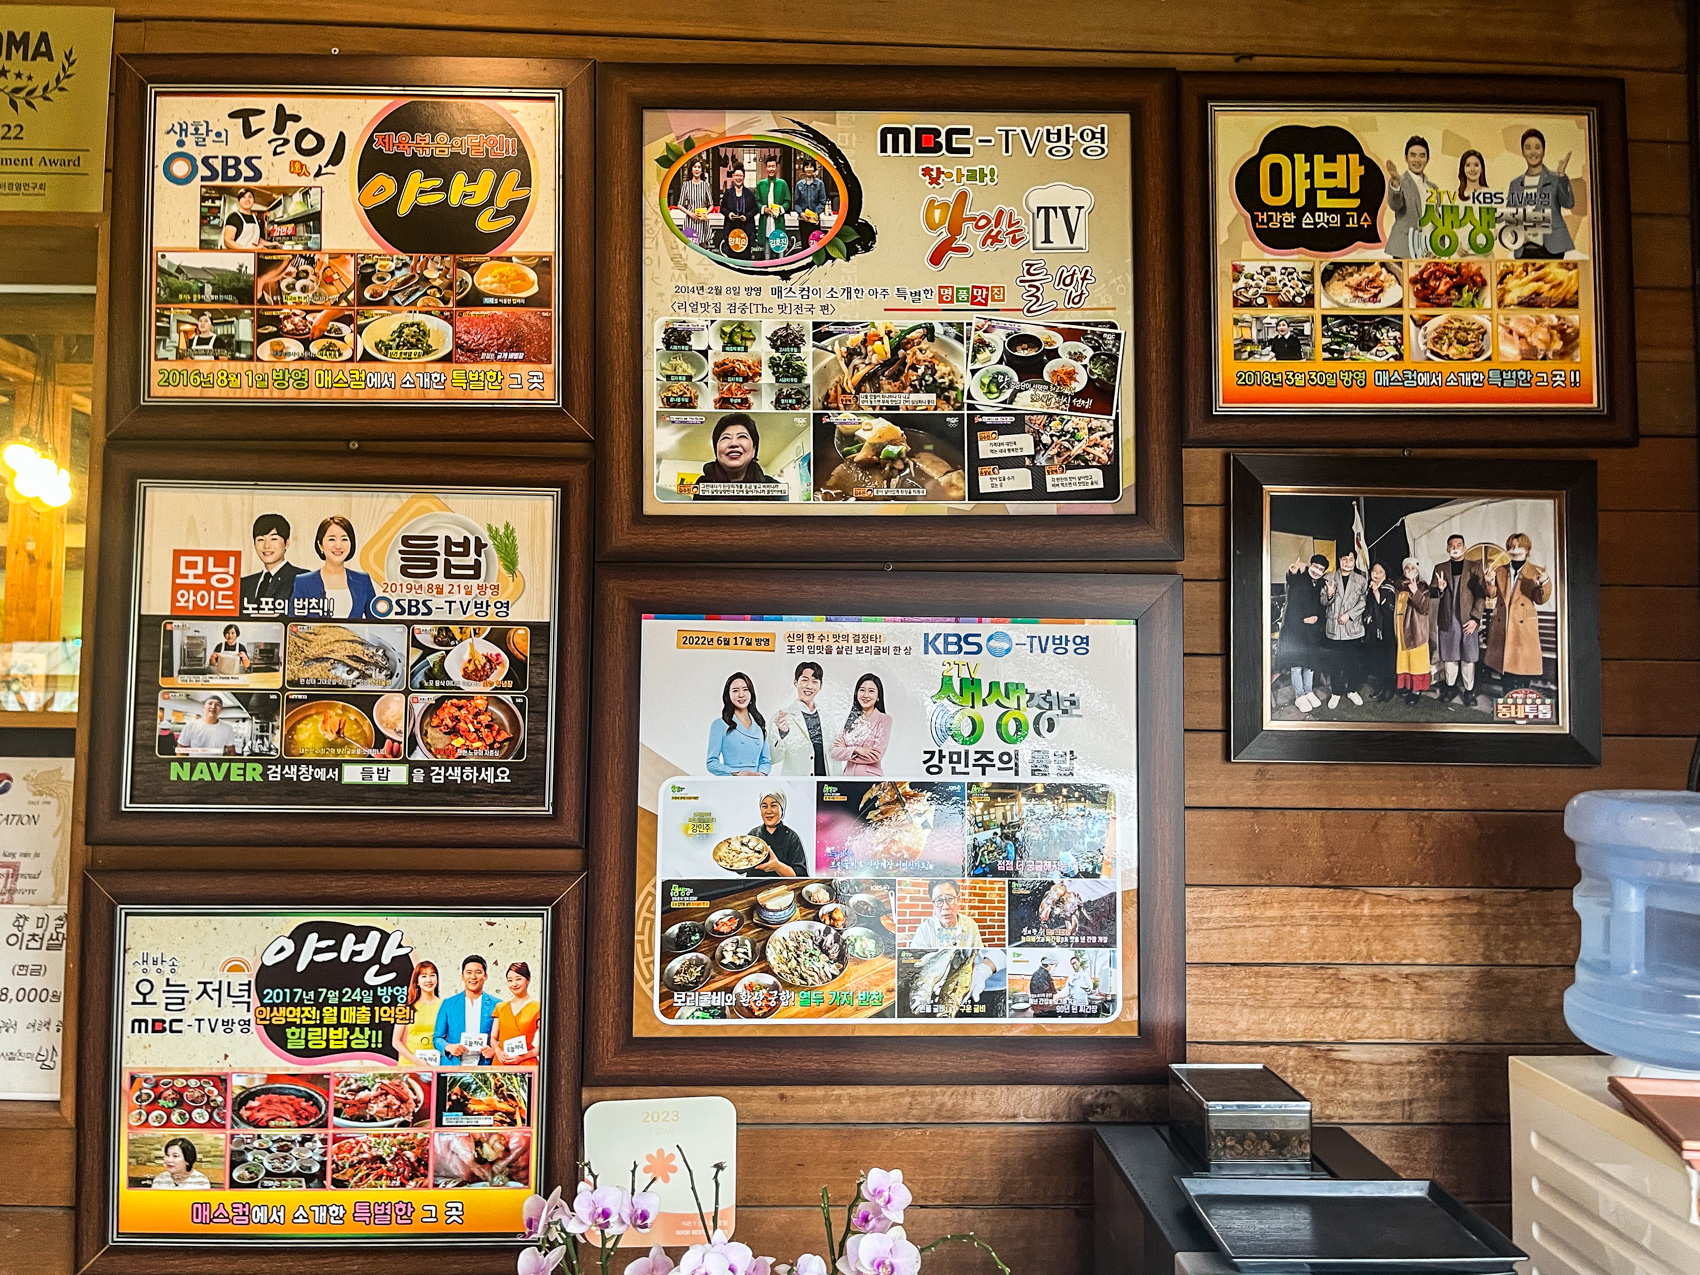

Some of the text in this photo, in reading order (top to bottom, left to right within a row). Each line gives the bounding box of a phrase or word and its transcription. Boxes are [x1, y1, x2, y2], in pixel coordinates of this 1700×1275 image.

[0, 31, 54, 62] MA
[166, 120, 229, 148] 생활의
[227, 103, 346, 179] 달인
[38, 156, 81, 167] Award
[200, 155, 263, 182] SBS
[921, 165, 998, 186] 찾아라!
[1259, 153, 1364, 208] 야반
[358, 168, 532, 233] 야반
[924, 188, 1085, 269] 맛있는 TV
[1254, 211, 1372, 229] 건강한 손맛의 고수
[674, 286, 705, 297] 2014년
[707, 286, 723, 297] 2월
[725, 286, 741, 297] 8일
[744, 286, 762, 297] 방영
[770, 286, 822, 300] 매스컴이
[825, 286, 865, 300] 소개한
[868, 286, 891, 300] 아주
[895, 287, 935, 304] 특별한
[157, 369, 544, 390] 2016년 8월 1일 방영 매스컴에서 소개한 특별한 그 곳
[1236, 370, 1580, 388] 2018년 3월 30일 방영 매스컴에서 소개한 특별한 그 곳 !!
[397, 533, 488, 580] 들밥
[175, 554, 236, 588] 모닝
[382, 582, 501, 596] 2019년 8월 21일 방영
[175, 589, 236, 612] 와이드
[242, 597, 289, 618] 노포의
[682, 635, 770, 647] 2022년 6월 17일 방영
[786, 632, 882, 643] 신의 한 수! 맛의 결정타!
[923, 632, 982, 655] KBS
[807, 644, 834, 654] 입맛을
[836, 645, 853, 655] 살린
[856, 645, 890, 656] 보리굴비
[892, 646, 901, 656] 한
[903, 646, 912, 655] 상
[942, 660, 980, 678] 2TV
[930, 674, 1083, 745] 생생정보
[169, 763, 512, 783] NAVER 검색창에서 들밥 을 검색하세요
[922, 749, 1019, 776] 강민주의
[132, 952, 179, 974] 생방송
[261, 930, 414, 986] 야반
[130, 976, 253, 1012] 오늘 저녁
[262, 986, 408, 1004] 2017년 7월 24일 방영
[673, 990, 736, 1006] 보리굴비와
[798, 990, 824, 1006] 열두
[828, 990, 853, 1006] 가지
[857, 990, 884, 1006] 반찬
[255, 1006, 321, 1026] 인생역전!
[322, 1006, 339, 1026] 월
[340, 1006, 370, 1026] 매출
[286, 1026, 383, 1050] 힐링밥상!!
[642, 1110, 680, 1123] 2023
[191, 1202, 464, 1225] 매스컴에서 소개한 특별한 그 곳
